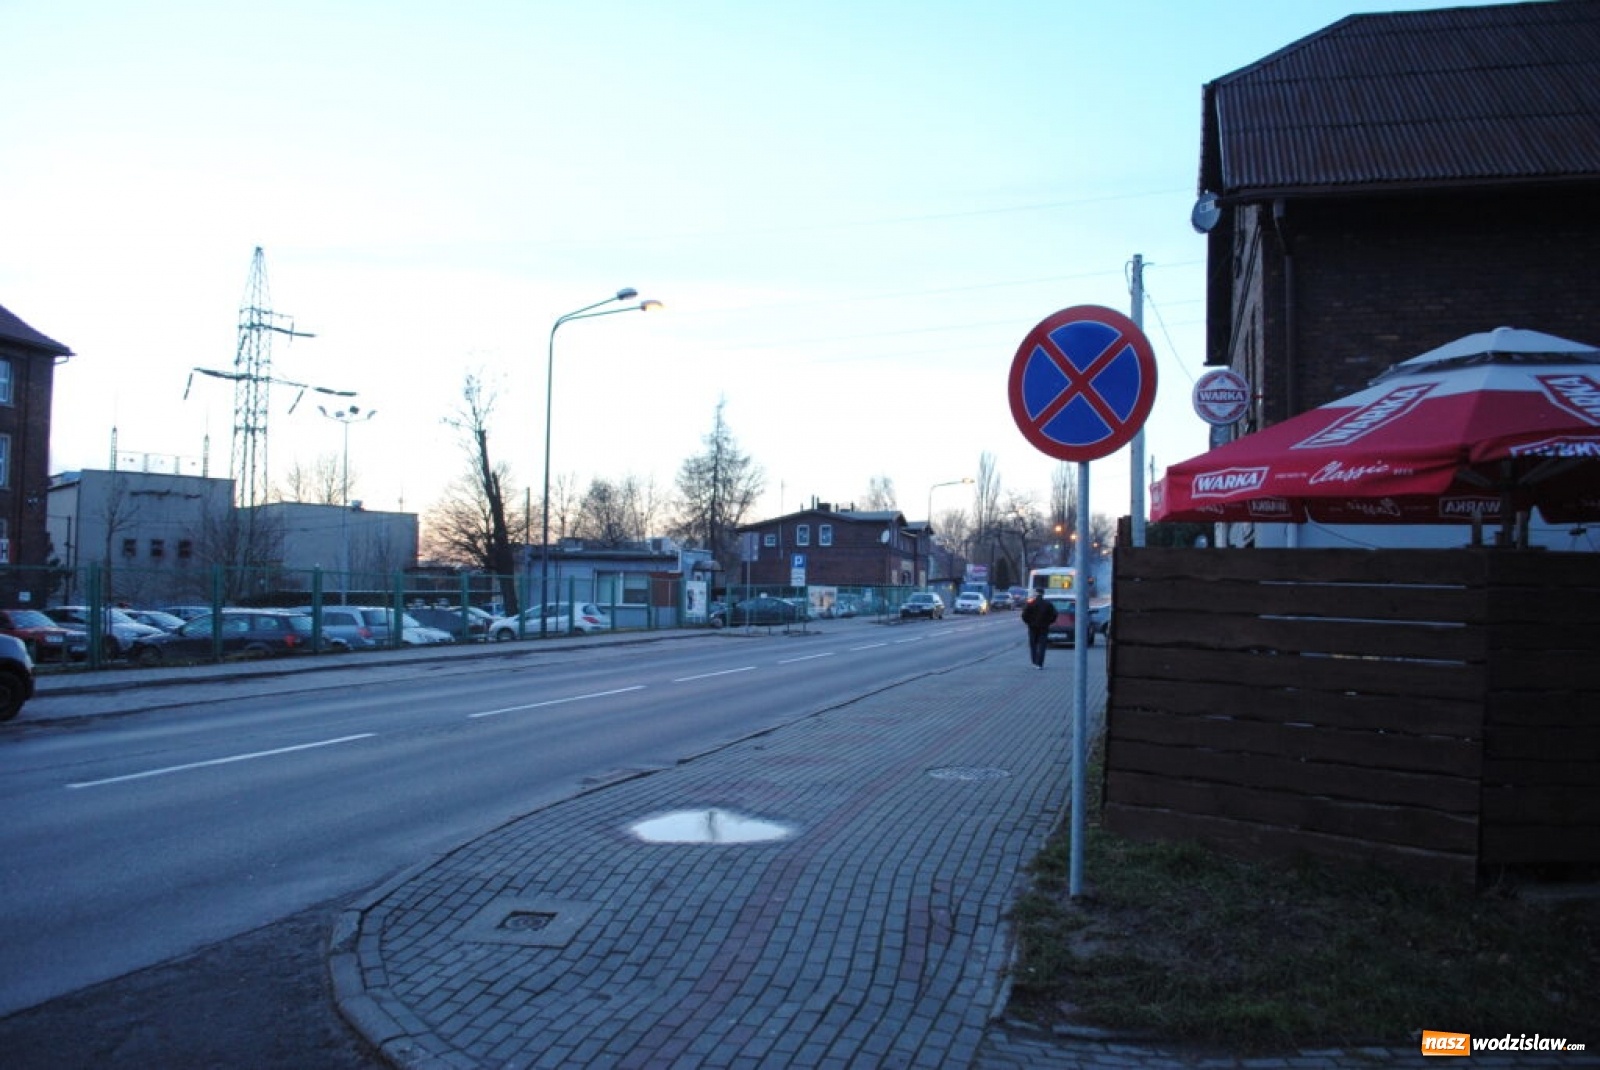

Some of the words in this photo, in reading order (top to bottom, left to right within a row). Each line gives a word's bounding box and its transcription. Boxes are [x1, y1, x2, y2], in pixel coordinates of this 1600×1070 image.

[1200, 391, 1244, 401] WARKA
[1309, 388, 1420, 446] WARKA
[1197, 472, 1259, 492] WARKA
[1309, 460, 1389, 485] Classic
